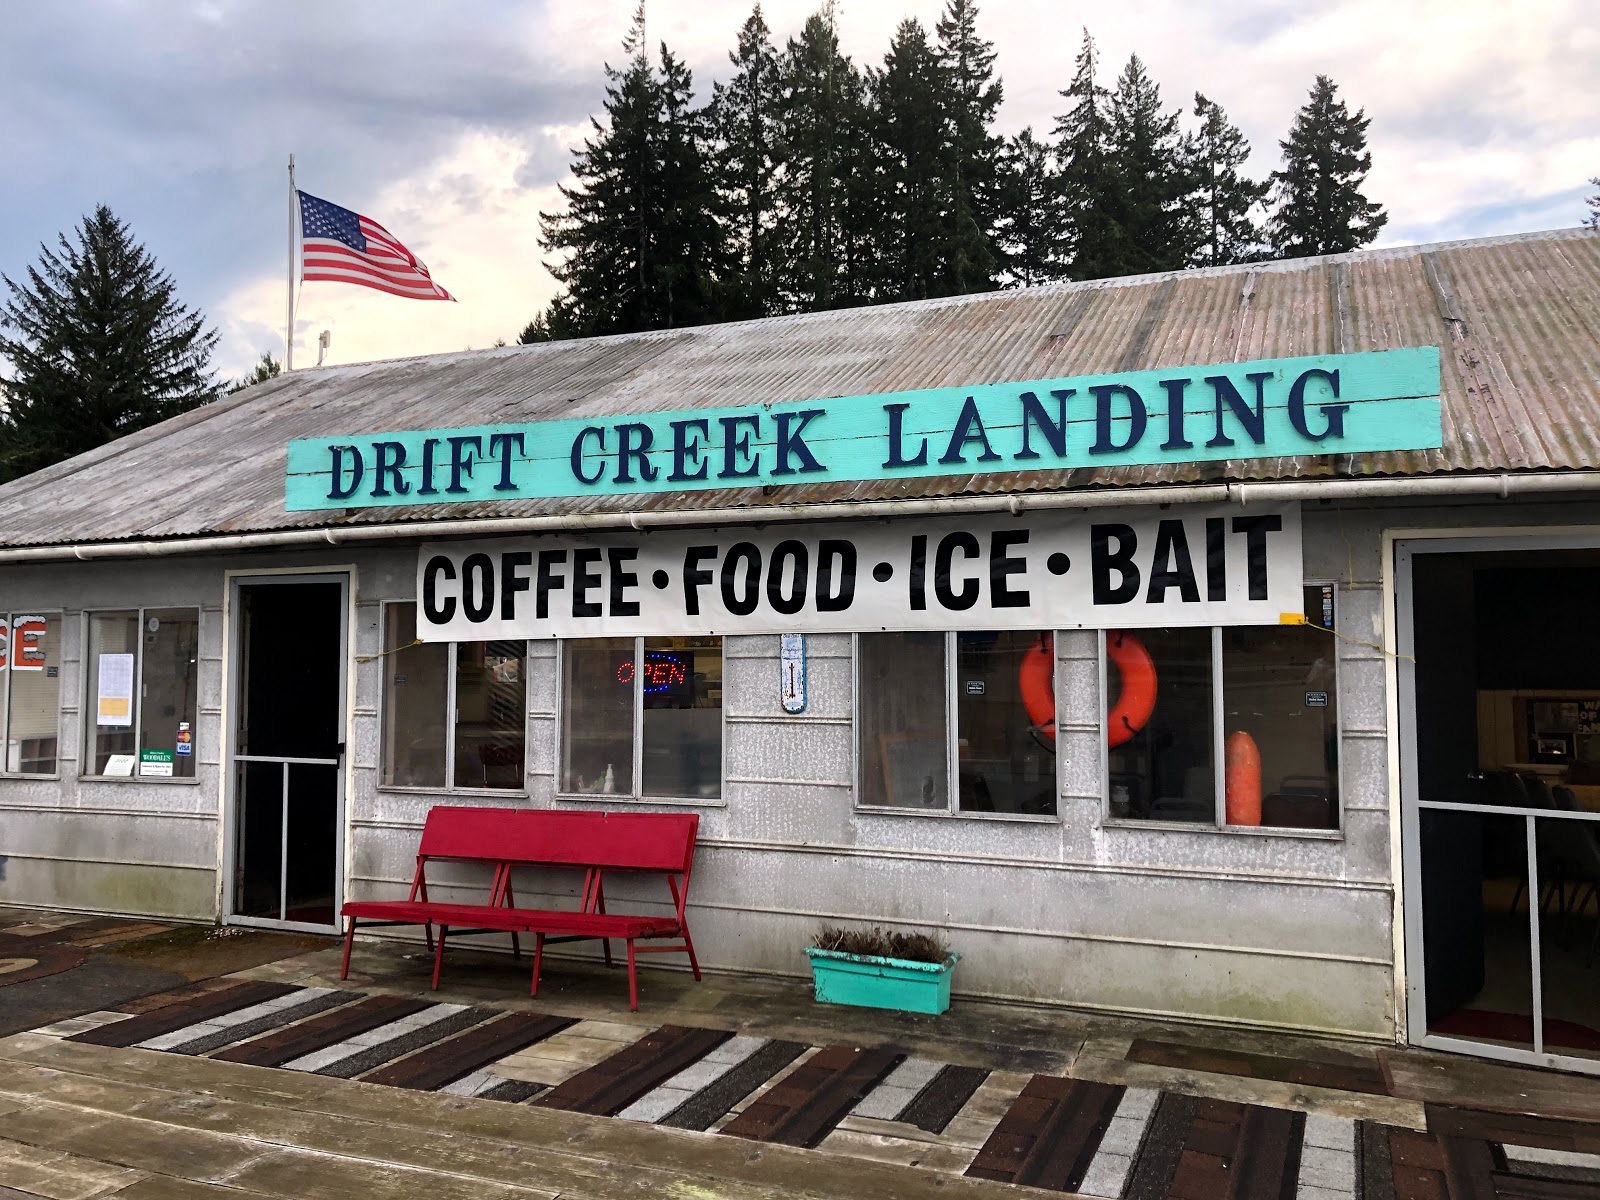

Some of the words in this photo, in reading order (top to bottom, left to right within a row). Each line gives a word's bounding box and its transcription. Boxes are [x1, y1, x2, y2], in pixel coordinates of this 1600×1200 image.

[326, 433, 527, 500] DRIFT
[569, 408, 829, 486] CREEK
[881, 368, 1350, 469] LANDING
[423, 546, 641, 625] COFFEE
[683, 538, 857, 616] FOOD
[909, 528, 1031, 611] ICE
[1090, 514, 1283, 606] BAIT
[616, 661, 687, 685] OPEN
